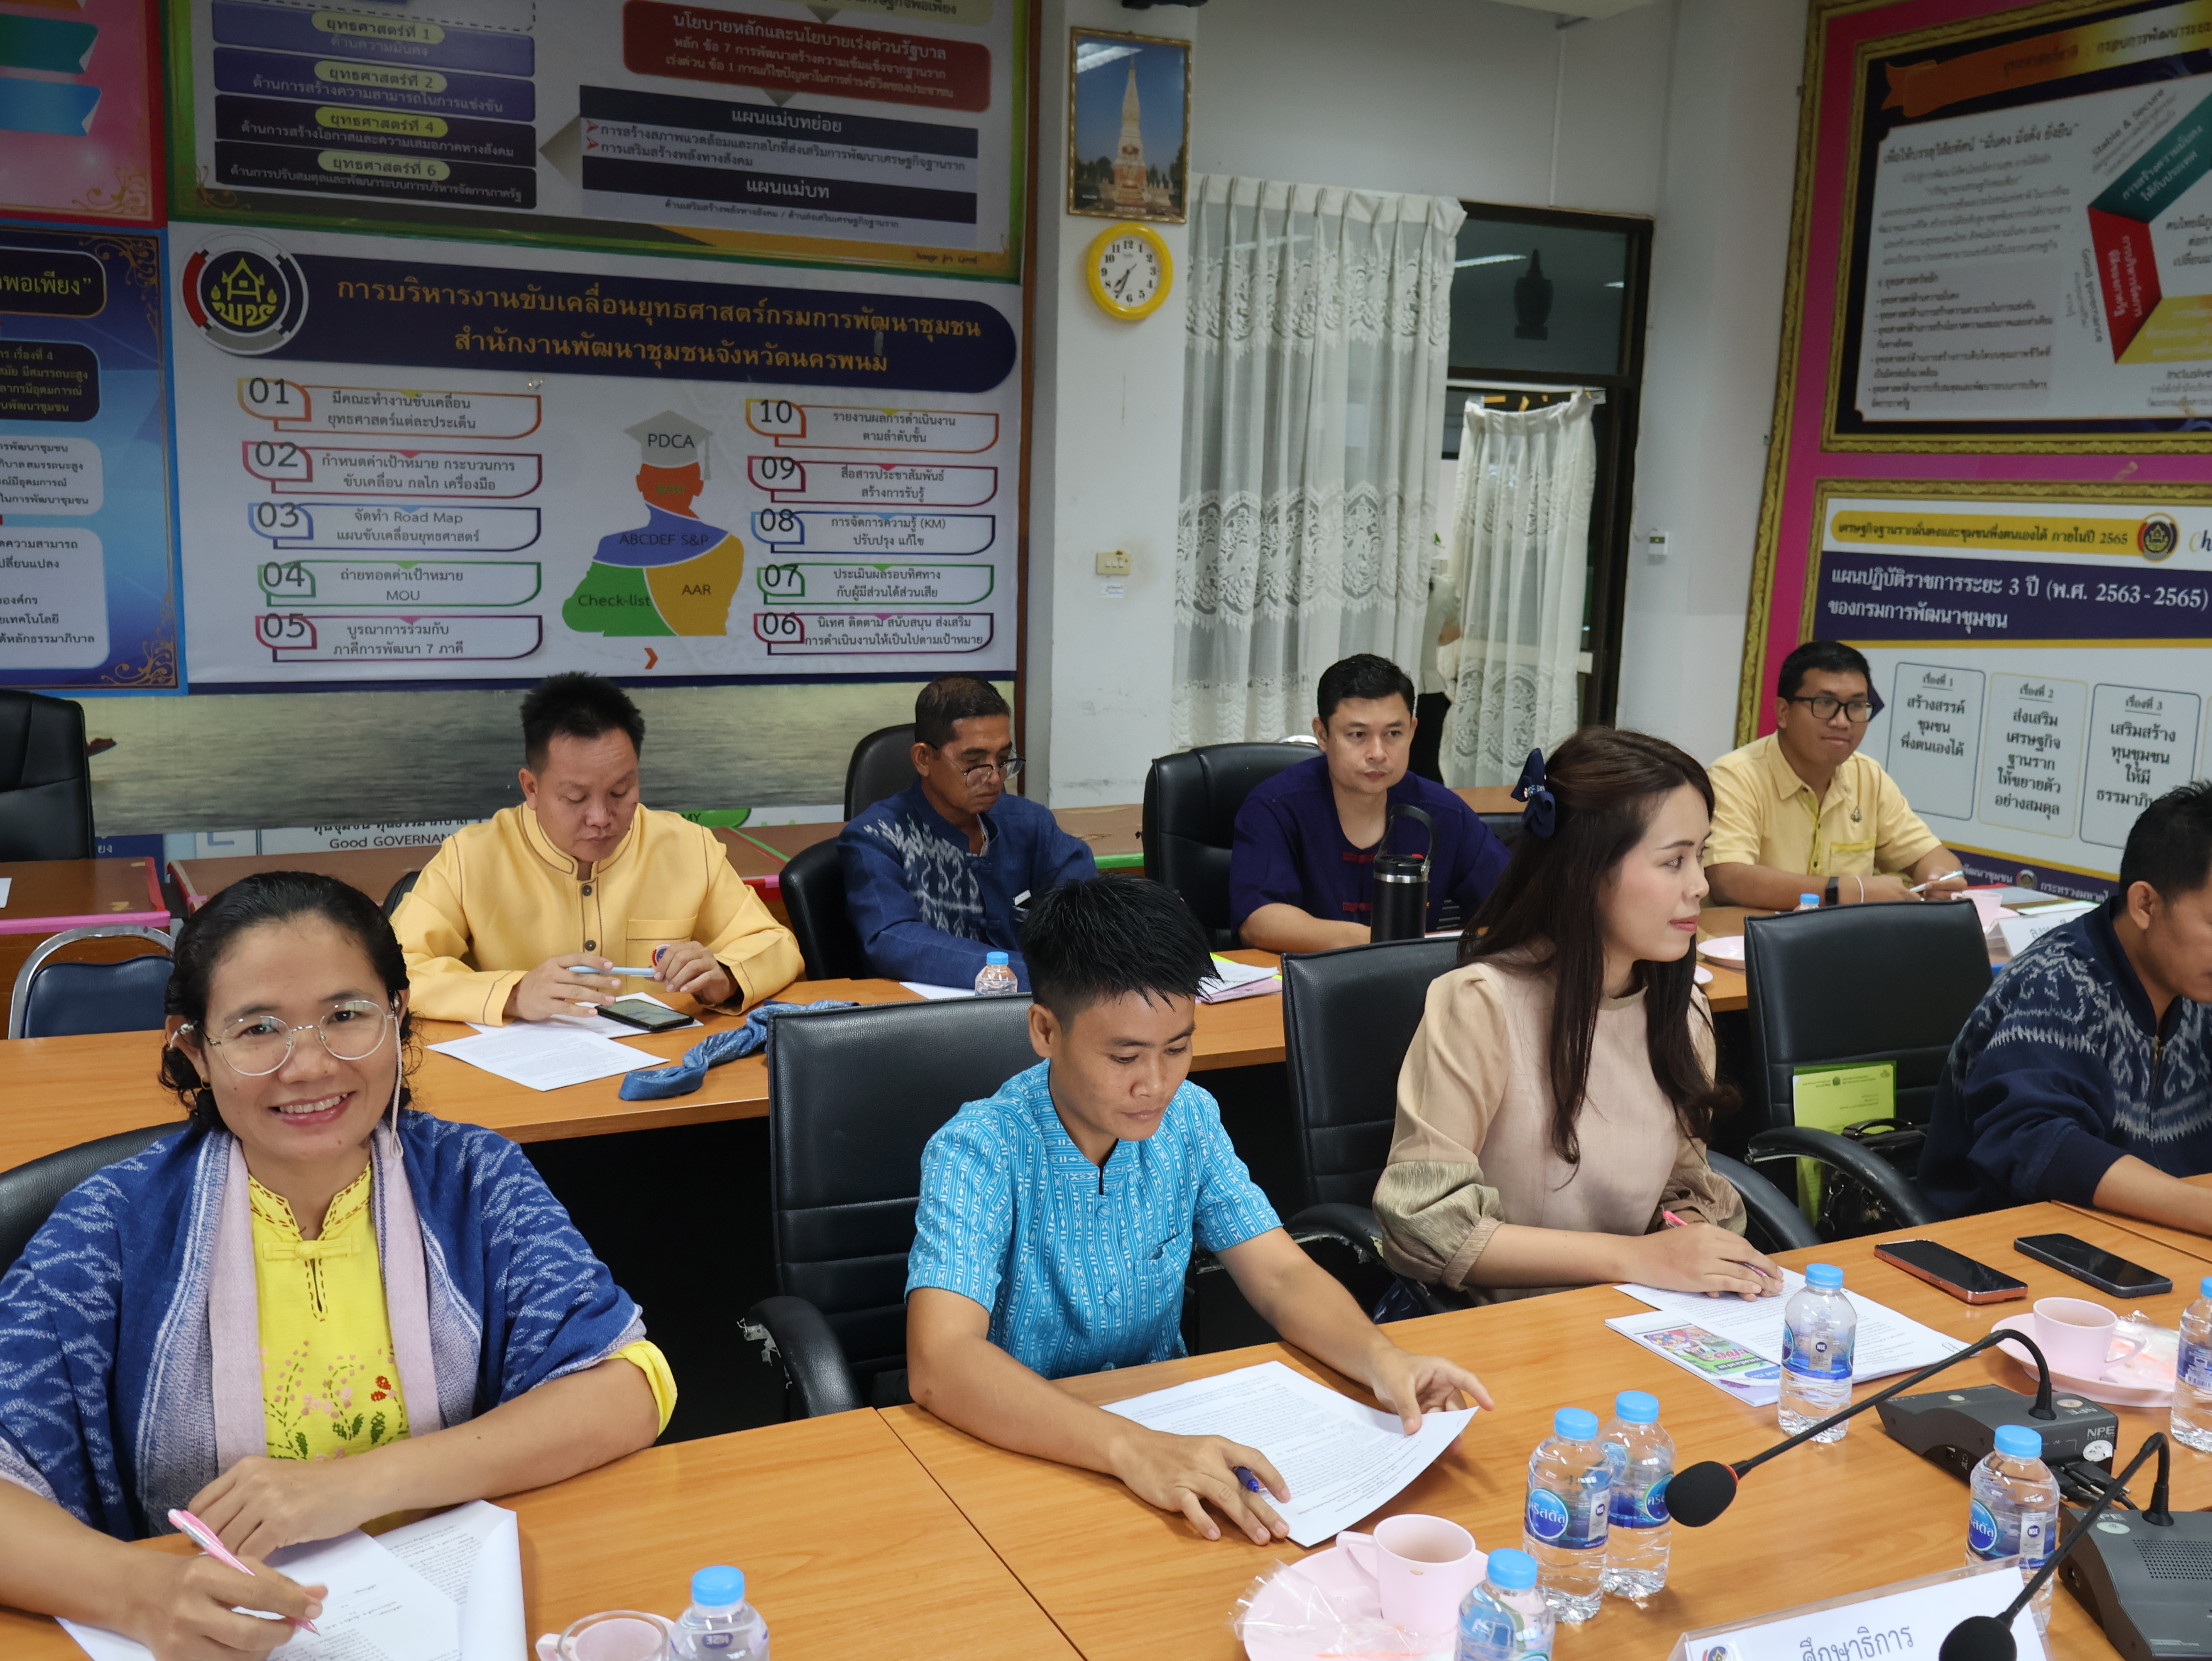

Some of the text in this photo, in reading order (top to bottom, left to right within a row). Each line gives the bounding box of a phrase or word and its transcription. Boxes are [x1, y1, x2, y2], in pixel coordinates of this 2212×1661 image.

[326, 20, 431, 39] ยุทธศาสตร์ที่ 1
[673, 10, 947, 61] นโยบายหลักและนโยบายเร่งด่วนรัฐบาล
[674, 37, 699, 50] หลัก
[705, 39, 719, 53] ข้อ
[724, 45, 731, 54] 7
[729, 62, 734, 72] 1
[330, 68, 433, 88] ยุทธศาสตร์ที่ 2
[252, 73, 504, 113] ด้านการสร้างความสามารถในการแข่งขัน
[330, 114, 434, 132] ยุทธศาสตร์ที่ 4
[732, 107, 842, 134] แผนแม่บทย่อย
[241, 119, 514, 158] ด้านการสร้างโอกาสและความเสมอภาคทางสังคม
[600, 140, 754, 167] การเสริมสร้างพลังทางสังคม
[333, 157, 437, 177] ยุทธศาสตร์ที่ 6
[746, 177, 830, 199] แผนแม่บท
[1112, 244, 1120, 253] 11
[1123, 240, 1134, 249] 12
[1105, 254, 1115, 263] 10
[1146, 253, 1152, 263] 2
[0, 271, 91, 295] พอเพียง”
[1126, 294, 1133, 303] 6
[337, 277, 980, 343] การบริหารงานขับเคลื่อนยุทธศาสตร์กรมการพัฒนาชุมชน
[47, 351, 53, 360] 4
[454, 328, 888, 372] สำนักงานพัฒนาชุมชนจังหวัดนครพนม
[249, 377, 290, 405] 01
[332, 391, 471, 410] มีคณะทำงานขับเคลื่อน
[328, 412, 476, 430] ยุทธศาสตร์แต่ละประเด็น
[760, 399, 793, 424] 10
[833, 411, 956, 426] รายงานผลการดำเนินงาน
[648, 434, 695, 448] PDCA
[255, 441, 299, 468] 02
[322, 453, 515, 472] กำหนดค่าเป้าหมาย กระบวนการ
[761, 456, 795, 481] 09
[841, 465, 945, 482] สื่อสารประชาสัมพันธ์
[343, 472, 496, 491] ขับเคลื่อน กลไก เครื่องมือ
[861, 485, 925, 502] สร้างการรับรู้
[257, 501, 300, 529] 03
[355, 510, 463, 525] จัดทำ Road Map
[760, 508, 794, 532] 08
[831, 514, 946, 533] การจัดการความรู้ (KM)
[337, 526, 480, 546] แผนขับเคลื่อนยุทธศาสตร์
[619, 533, 710, 546] ABCDEF S&P
[853, 534, 924, 549] ปรับปรุง แก้ไข
[2051, 527, 2095, 544] ภายในปี
[2099, 532, 2128, 545] 2565
[263, 561, 305, 588] 04
[340, 567, 463, 582] ถ่ายทอดค่าเป้าหมาย
[765, 563, 799, 588] 07
[834, 568, 941, 580] ประเมินผลรอบทิศทาง
[1832, 564, 2003, 595] แผนปฏิบัติราชการระยะ
[2009, 582, 2019, 596] 3
[2026, 576, 2039, 598] ปี
[2046, 581, 2087, 601] (พ.ศ.
[0, 593, 38, 606] องค์กร
[386, 590, 420, 601] MOU
[682, 584, 711, 596] AAR
[837, 586, 938, 601] กับผู้มีส่วนได้ส่วนเสีย
[763, 612, 797, 635] 06
[817, 616, 971, 630] นิเทศ ติดตาม สนับสนุน ส่งเสริม
[1828, 599, 2008, 632] ของกรมการพัฒนาชุมชน
[264, 613, 305, 639] 05
[347, 622, 449, 637] บูรณาการร่วมกับ
[333, 641, 463, 656] ภาคีการพัฒนา 7 ภาคี
[805, 632, 983, 646] การดำเนินงานให้เป็นไปตามเป้าหมาย
[2048, 689, 2054, 698] 2
[1907, 693, 1966, 714] สร้างสรรค์
[2156, 701, 2163, 711] 3
[2013, 707, 2058, 727] ส่งเสริม
[1918, 719, 1950, 736] ชุมชน
[2110, 720, 2176, 742] เสริมสร้าง
[1901, 731, 1965, 757] พึ่งตนเองได้
[2006, 730, 2061, 752] เศรษฐกิจ
[2007, 753, 2055, 771] ฐานราก
[2111, 745, 2170, 765] ทุนชุมชน
[1997, 765, 2061, 794] ให้ขยายตัว
[2125, 763, 2151, 785] ให้มี
[1994, 793, 2060, 821] อย่างสมดุล
[330, 834, 451, 848] Good GOVERNAN
[2087, 1426, 2115, 1437] NPE
